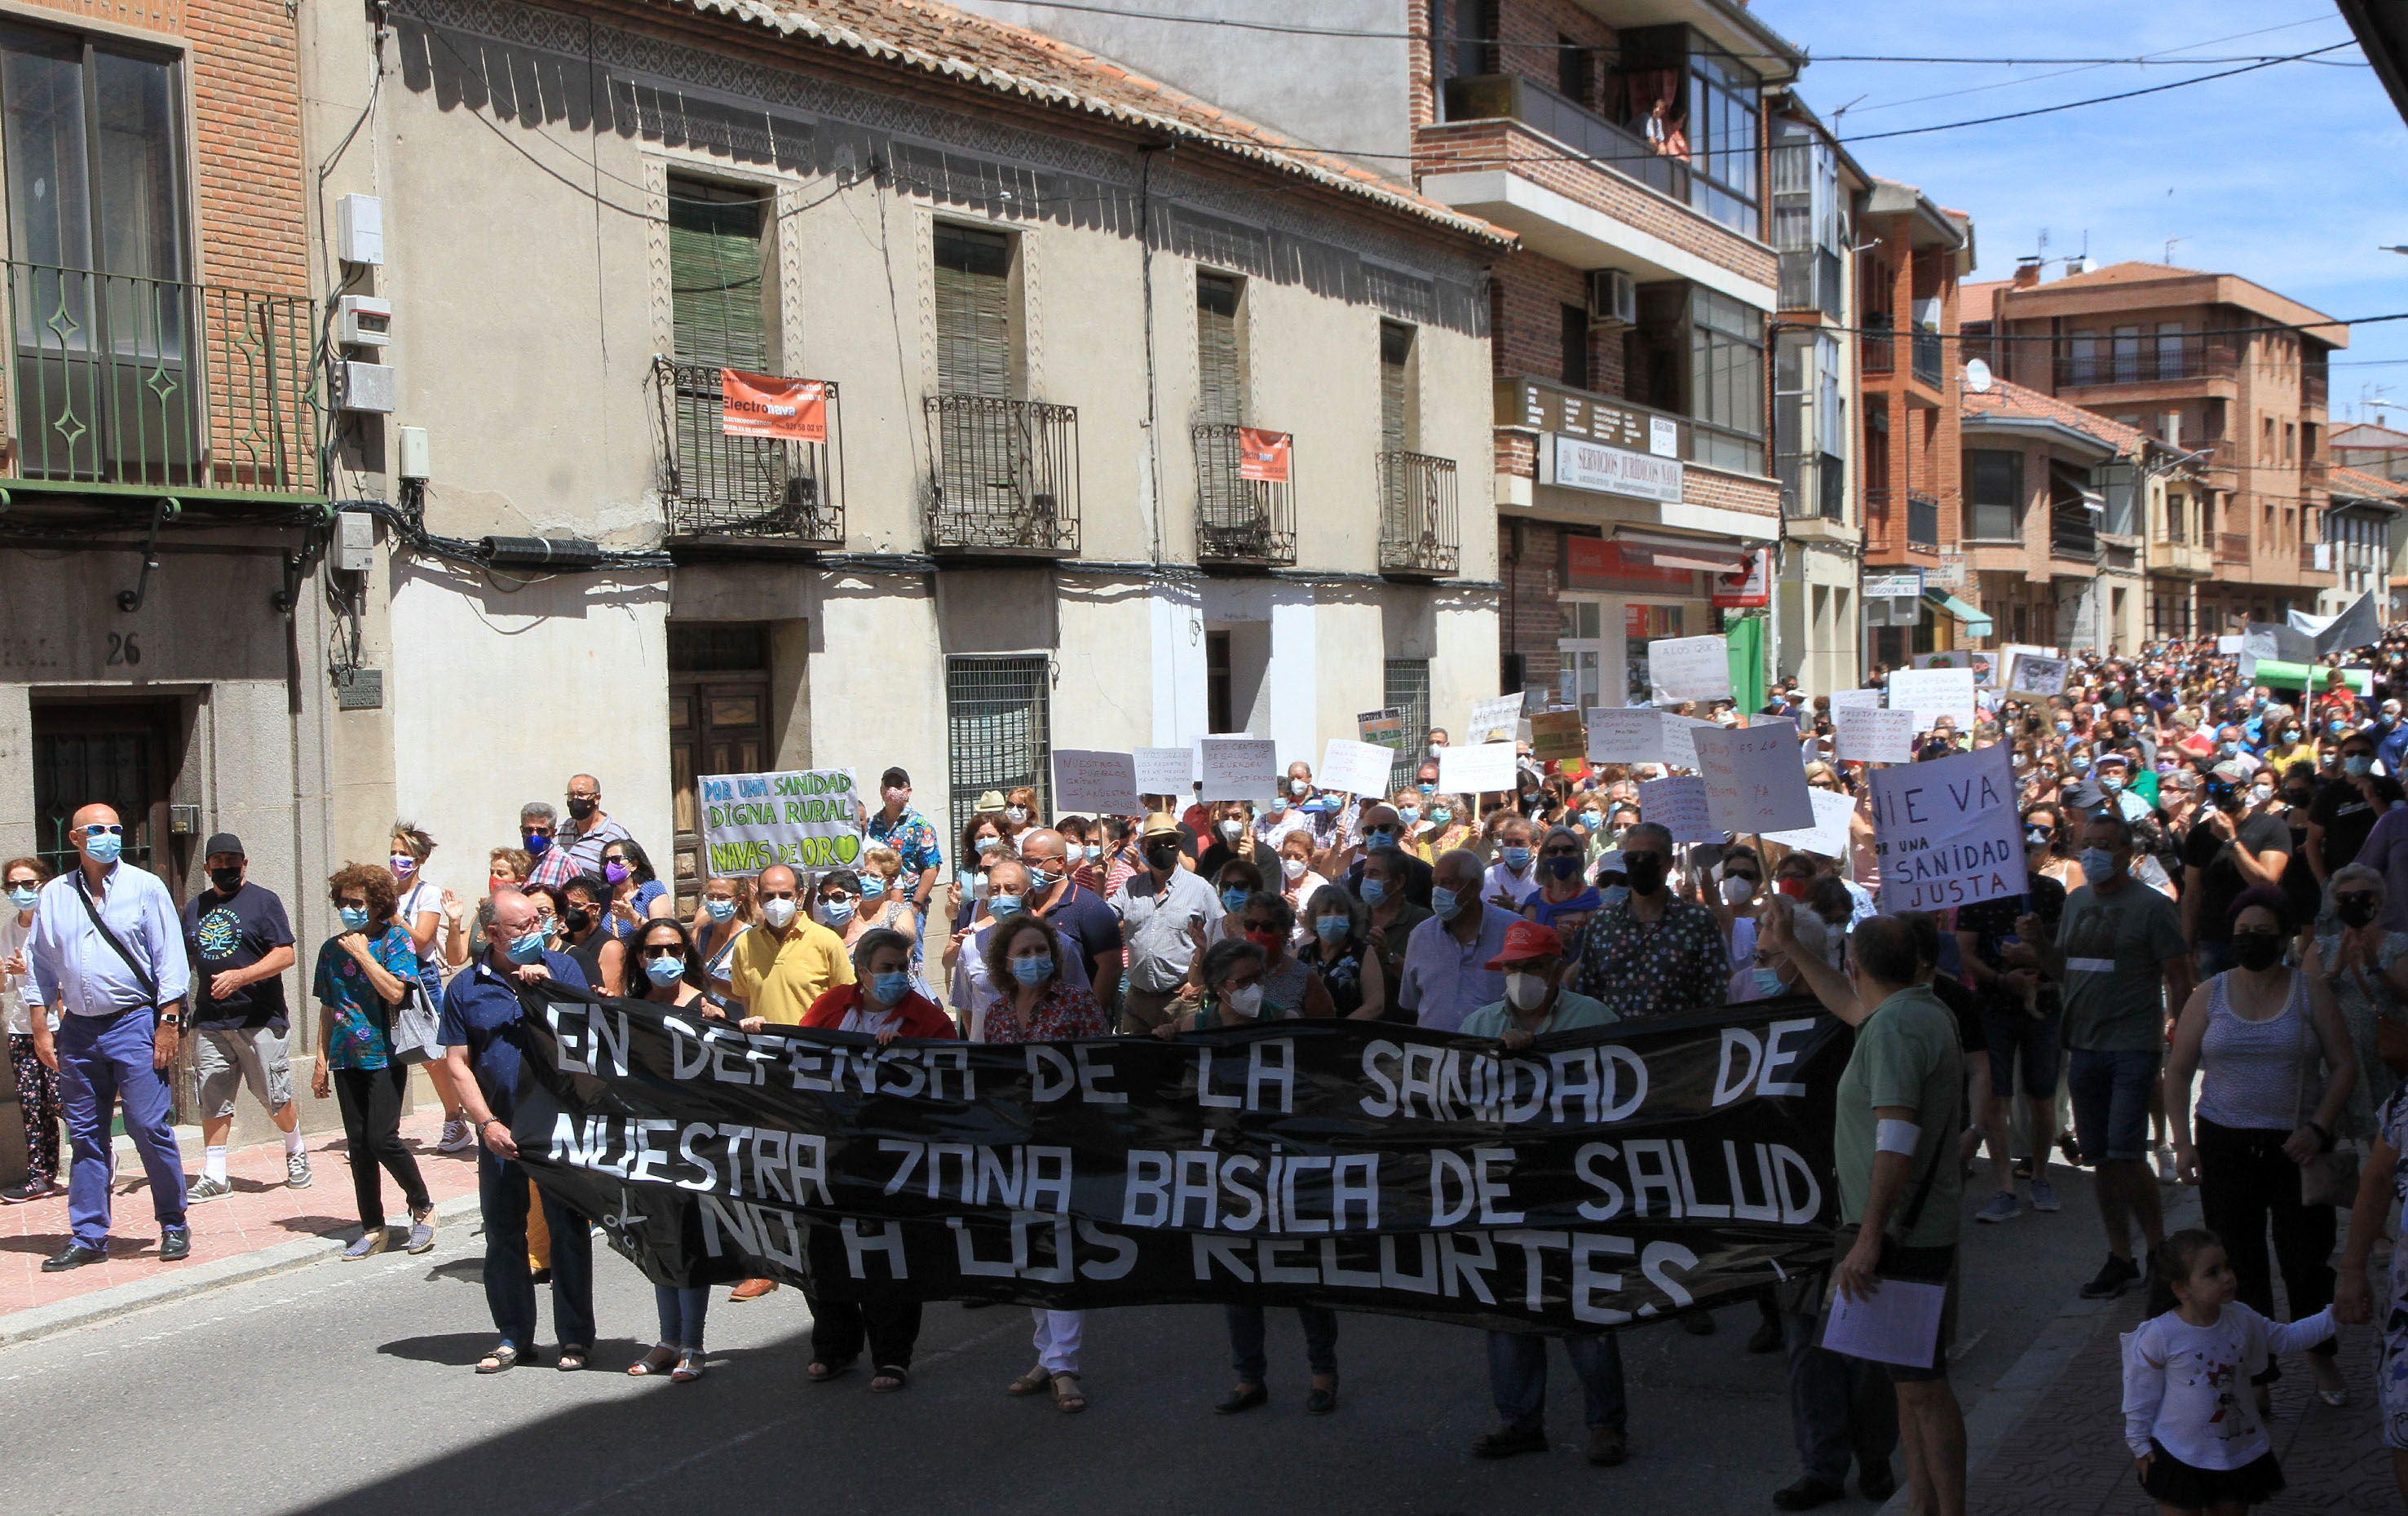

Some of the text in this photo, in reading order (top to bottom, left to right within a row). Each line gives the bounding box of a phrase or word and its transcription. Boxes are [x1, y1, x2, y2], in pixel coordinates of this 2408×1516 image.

[1578, 447, 1618, 477] SERVICIOS
[106, 631, 141, 666] 26
[704, 772, 852, 802] POR UNA SANIDAD
[709, 799, 854, 828] DIGNA RURAL
[710, 840, 772, 873] NAVAS
[778, 843, 798, 864] DE
[1896, 838, 2010, 885] SANIDAD
[1899, 837, 1930, 853] UNA
[1911, 873, 2008, 908] JUSTA
[546, 1002, 1817, 1124] EN DEFENSA DE LA SANIDAD DE
[547, 1112, 1823, 1234] NUESTRA ZONA BÁSICA DE SALUD
[697, 1193, 805, 1274] NO
